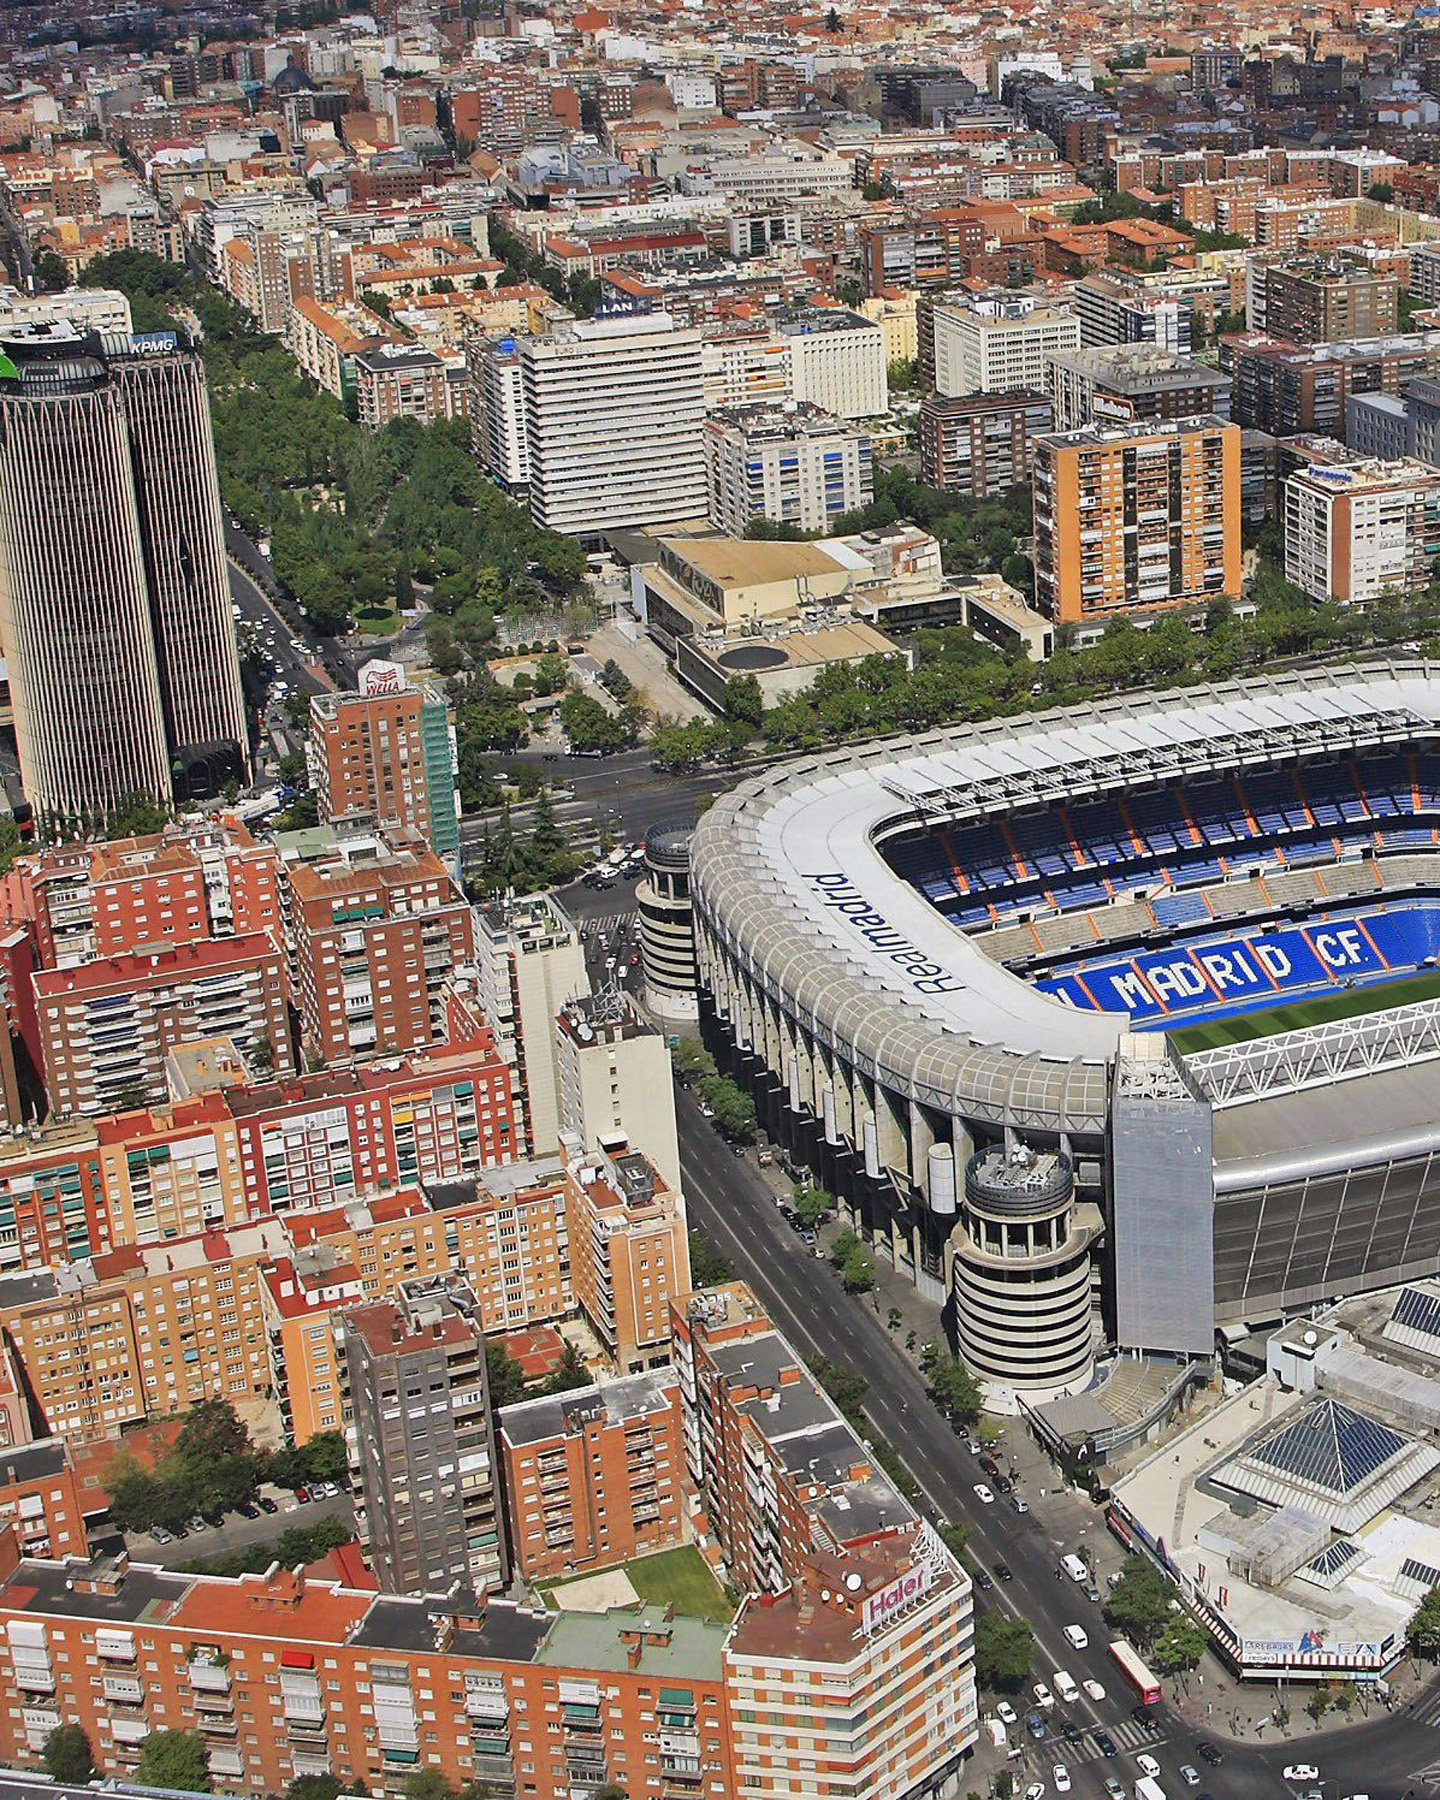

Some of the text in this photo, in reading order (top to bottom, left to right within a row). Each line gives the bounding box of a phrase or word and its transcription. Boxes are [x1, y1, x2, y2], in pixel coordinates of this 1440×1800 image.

[602, 302, 634, 314] LAN
[130, 339, 174, 355] KPMG
[366, 681, 400, 695] WELLA
[1109, 944, 1292, 1009] MADRID
[869, 1569, 925, 1622] Haier
